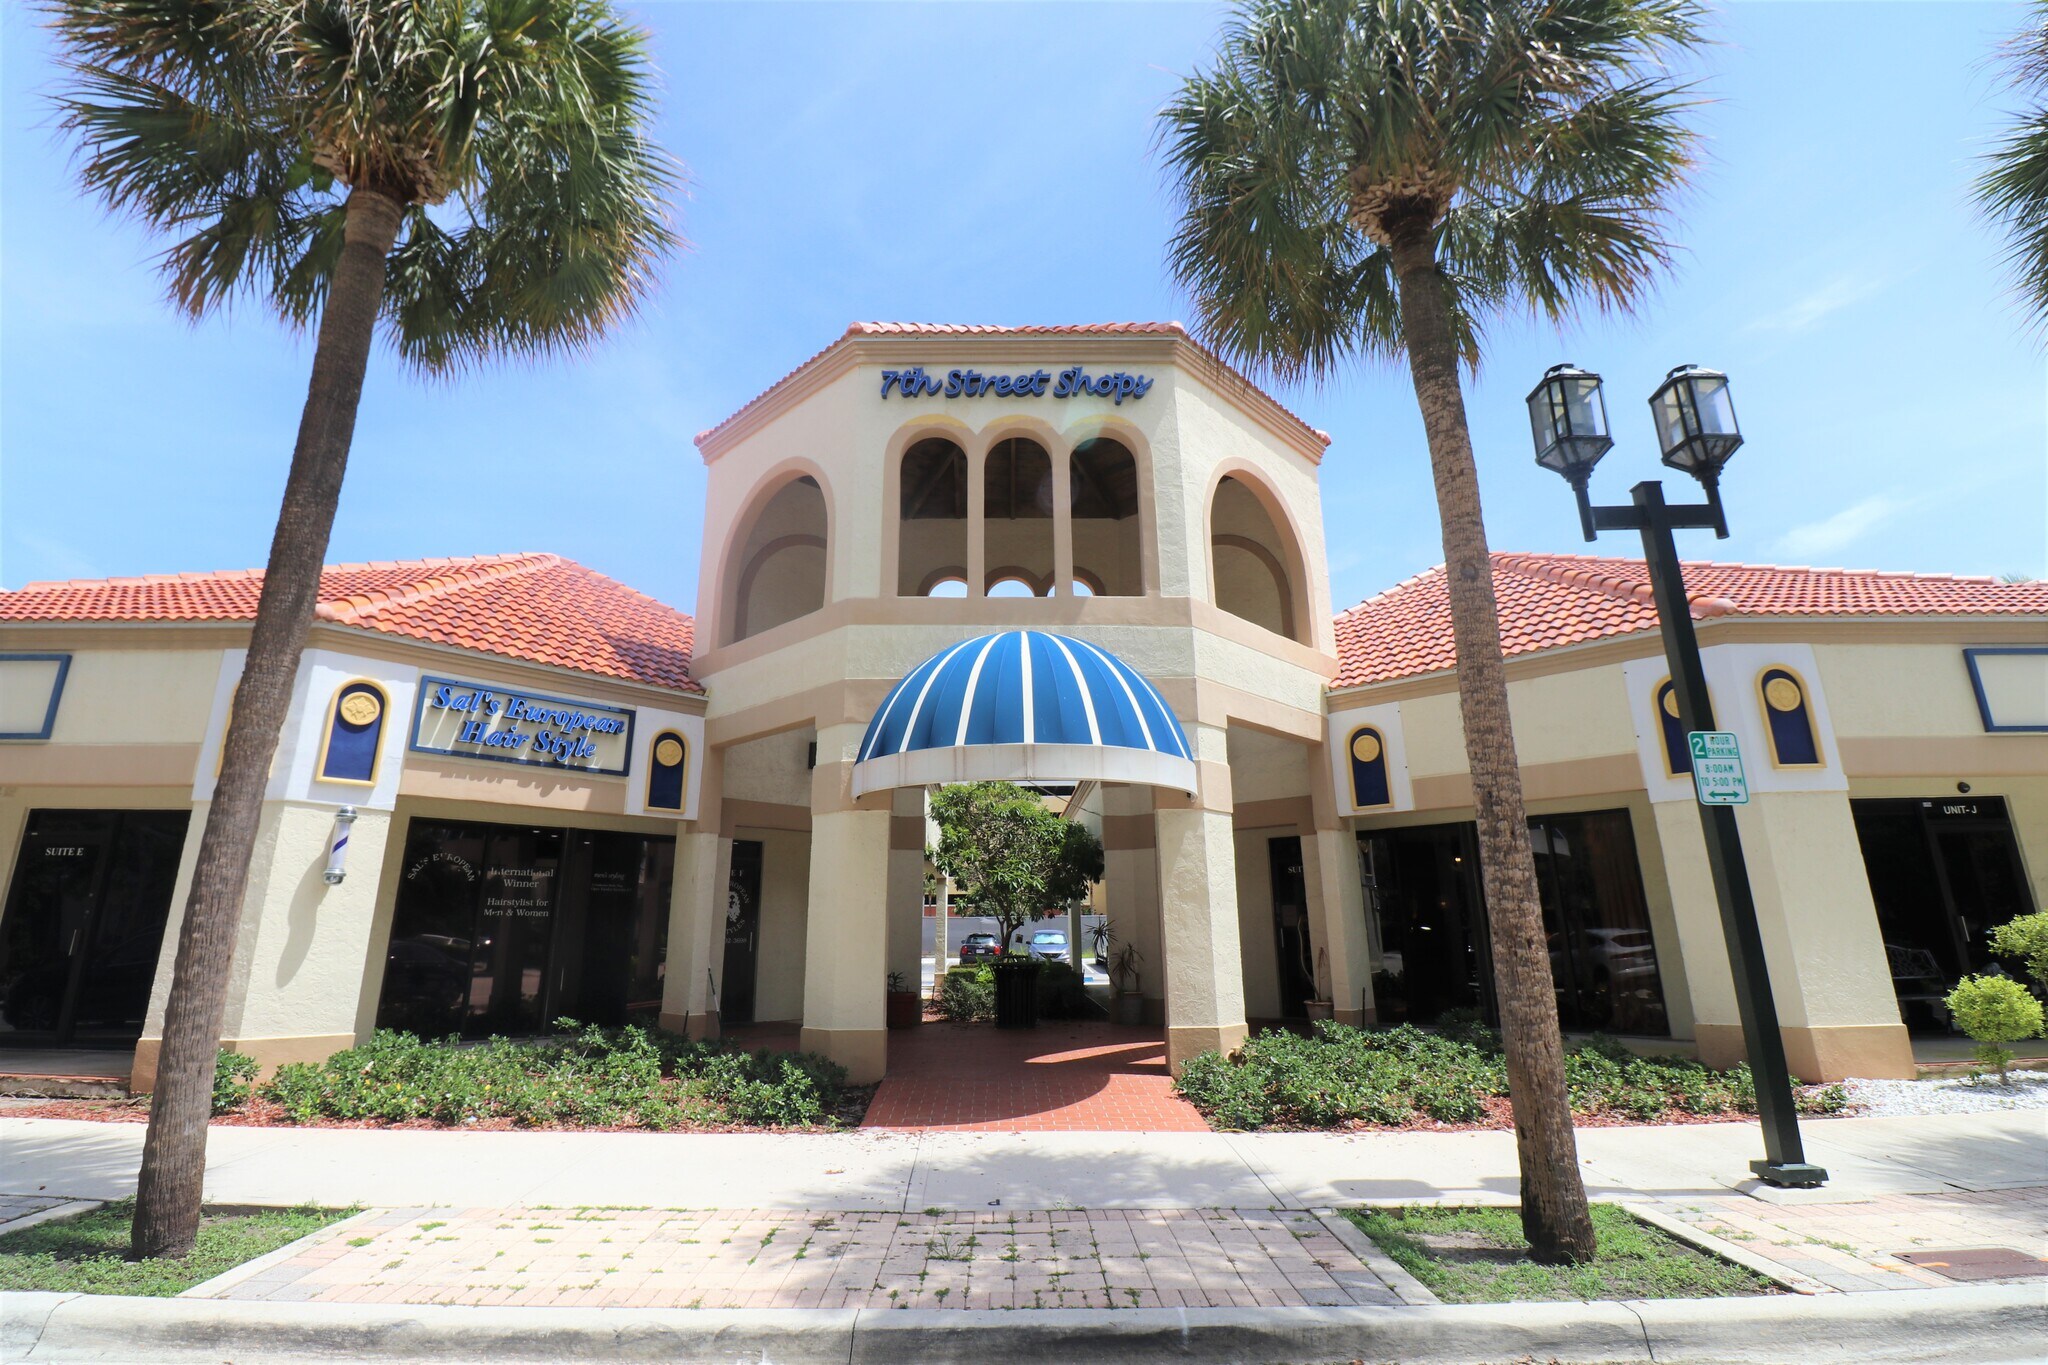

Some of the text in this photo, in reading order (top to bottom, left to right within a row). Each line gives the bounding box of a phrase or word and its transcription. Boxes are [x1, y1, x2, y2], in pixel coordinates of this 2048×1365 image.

[881, 366, 1154, 406] 7th Street Shops
[433, 685, 626, 735] Sal's European
[458, 720, 598, 763] Hair Style
[1692, 736, 1730, 755] 2 HOUR
[1707, 747, 1737, 756] PARKING
[1701, 777, 1743, 786] TO 5:00 PM
[45, 847, 84, 856] SUITE E
[504, 878, 540, 888] Winner
[487, 898, 549, 908] Hairstylist for
[505, 908, 514, 917] &
[516, 908, 550, 917] Women
